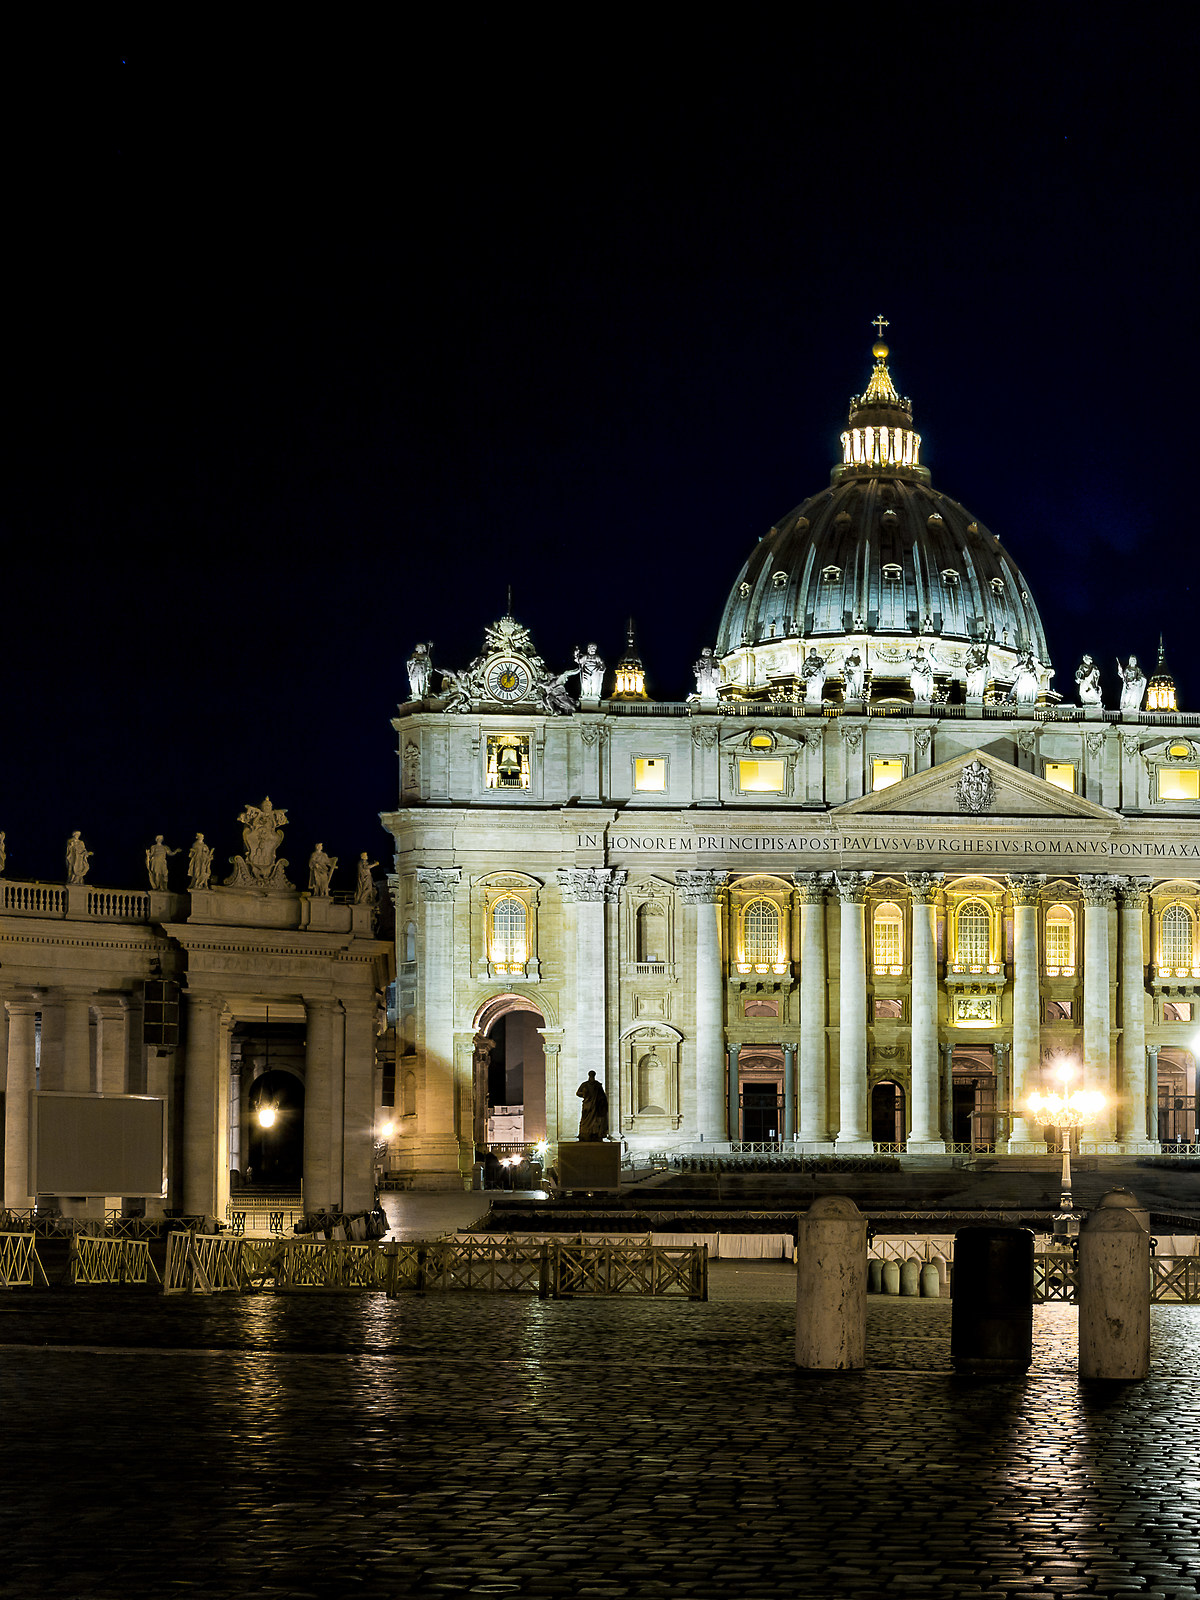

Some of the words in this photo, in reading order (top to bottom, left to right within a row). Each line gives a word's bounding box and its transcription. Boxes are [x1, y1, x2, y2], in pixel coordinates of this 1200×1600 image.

[576, 834, 597, 847] IN
[698, 836, 785, 851] PRINCIPIS
[787, 837, 839, 851] APOST
[842, 837, 899, 850] PAVLVS
[916, 838, 1019, 852] BVRGHESIVS
[1024, 839, 1107, 854] ROMANVS
[1110, 842, 1152, 856] PONT
[1153, 843, 1188, 856] MAX
